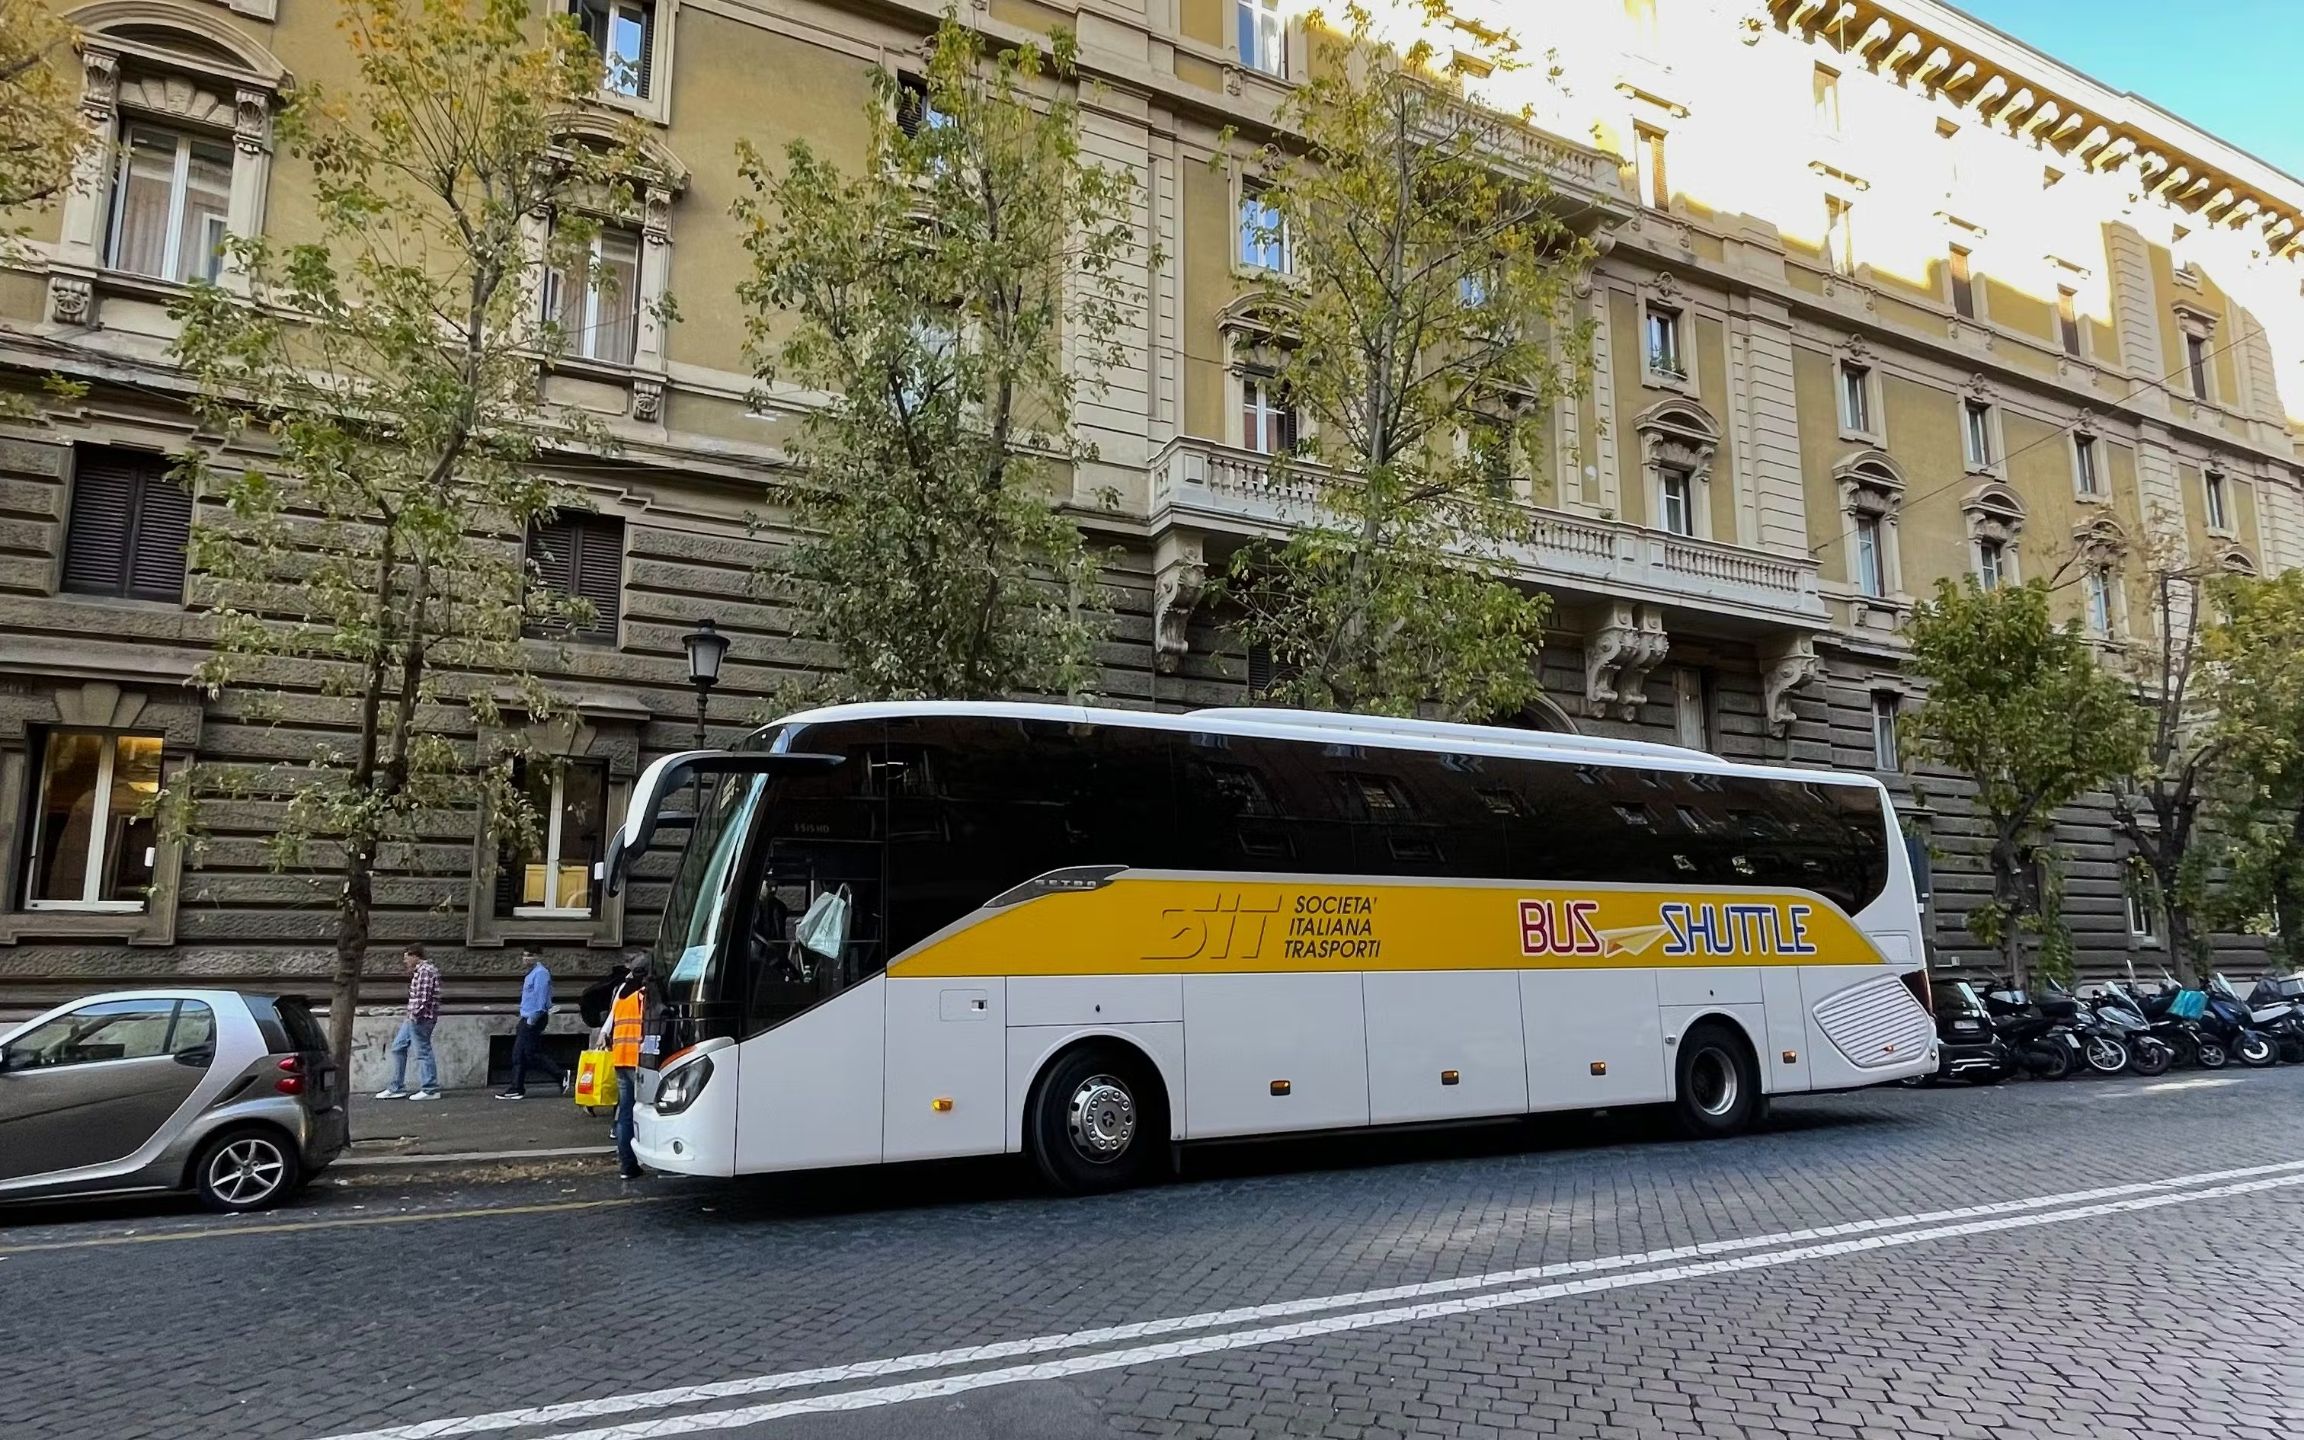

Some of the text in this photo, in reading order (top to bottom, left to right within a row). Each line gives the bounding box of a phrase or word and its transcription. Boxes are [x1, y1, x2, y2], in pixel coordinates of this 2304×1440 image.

[1294, 895, 1378, 914] SOCIETA'
[1289, 917, 1372, 936] ITALIANA
[1519, 899, 1817, 956] BUS SHUTTLE
[1284, 939, 1381, 959] TRASPORTI
